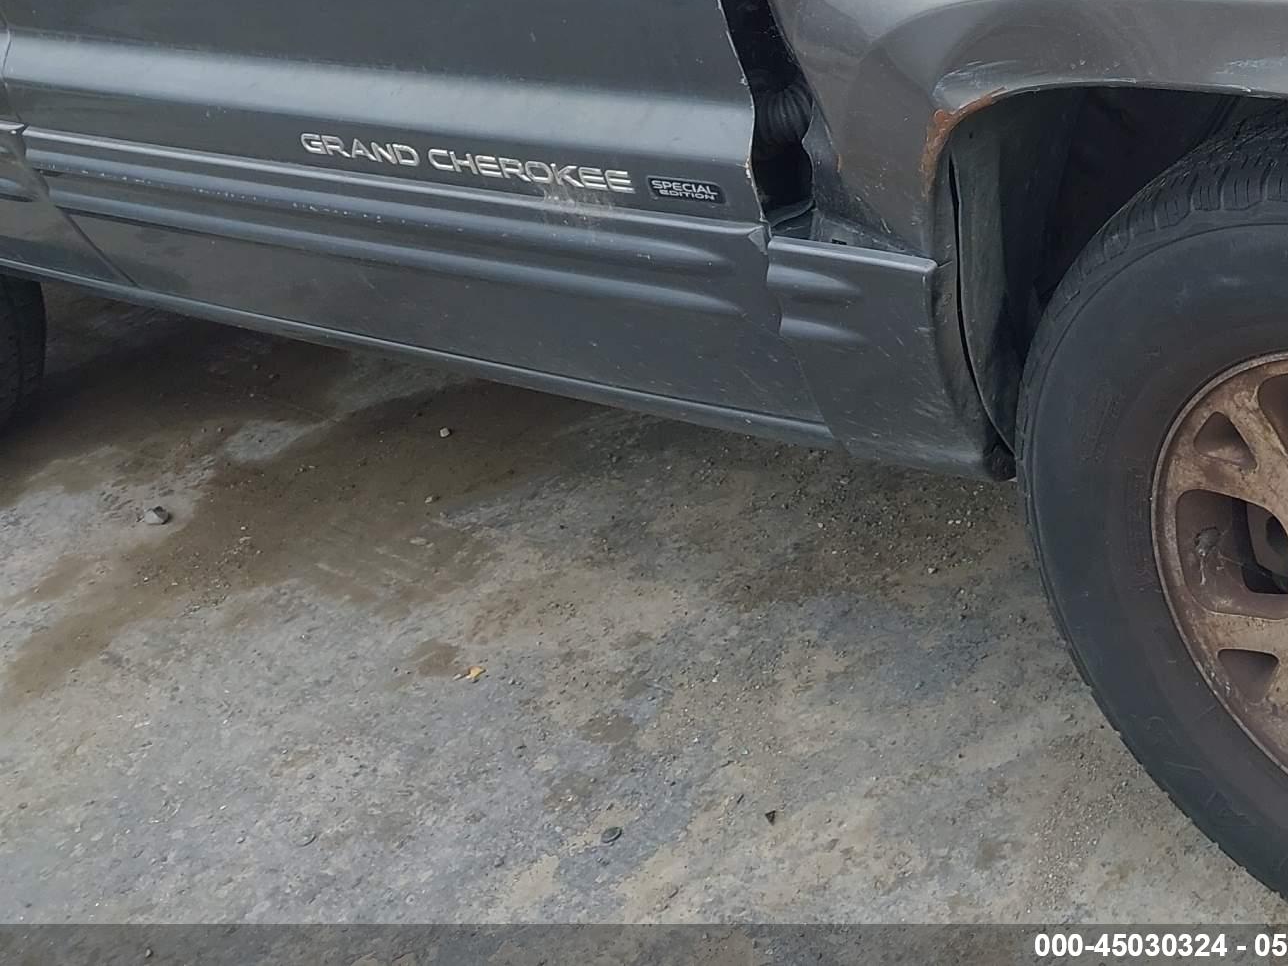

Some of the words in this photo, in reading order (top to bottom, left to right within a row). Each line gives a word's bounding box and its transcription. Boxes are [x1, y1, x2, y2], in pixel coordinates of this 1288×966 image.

[300, 133, 420, 167] GRAND
[428, 148, 636, 194] CHEROKEE
[651, 179, 718, 195] SPECIAL
[659, 189, 716, 201] EDITION
